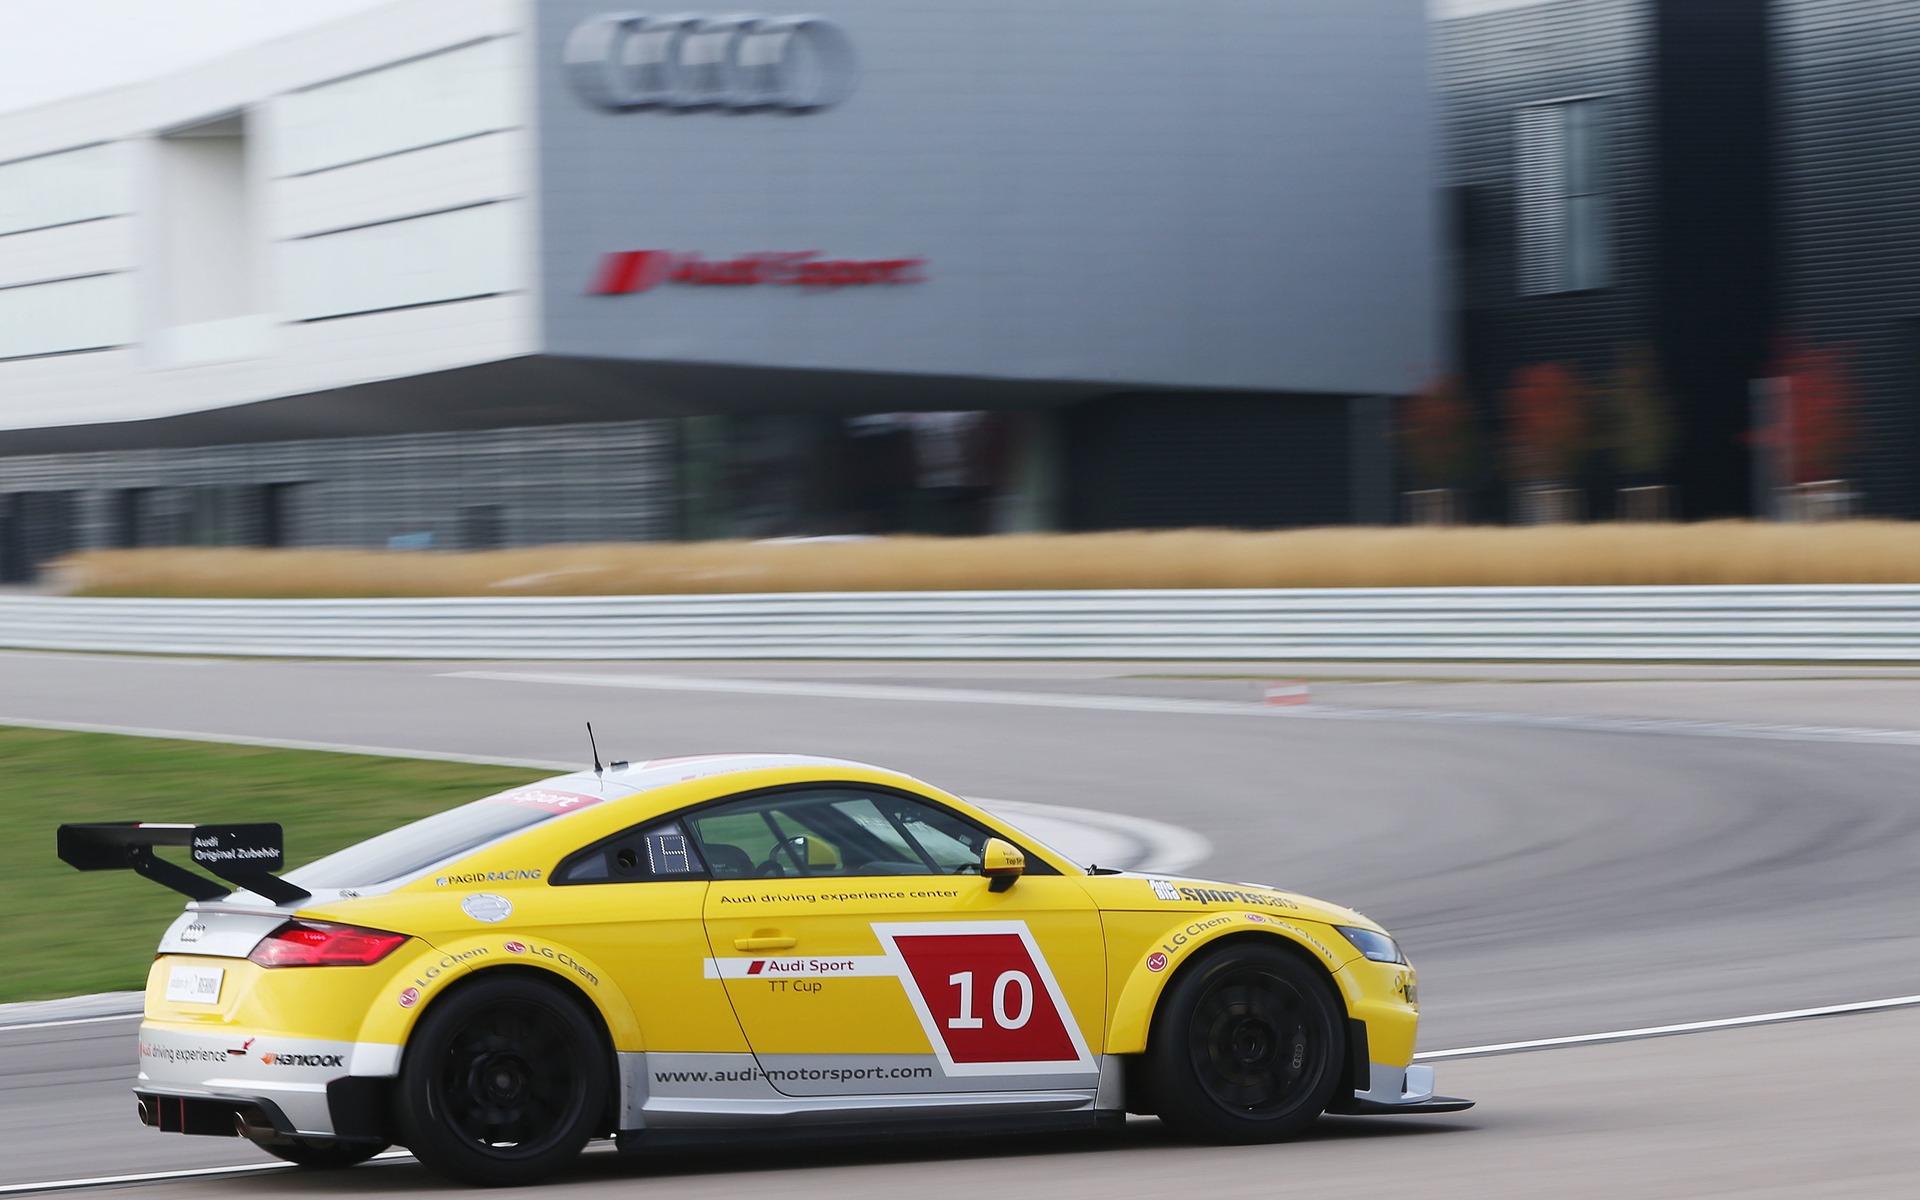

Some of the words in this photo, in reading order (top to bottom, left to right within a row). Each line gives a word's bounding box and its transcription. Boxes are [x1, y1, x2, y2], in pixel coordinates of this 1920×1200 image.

[194, 836, 219, 847] Audi
[194, 849, 236, 862] Original
[237, 848, 280, 859] Zubehör
[448, 873, 485, 885] PAGID
[486, 869, 542, 881] RACING
[720, 895, 756, 904] Audi
[761, 893, 816, 902] driving
[821, 891, 905, 901] experience
[910, 890, 959, 898] center
[1163, 933, 1188, 953] LG
[1186, 916, 1232, 936] Chem
[416, 965, 441, 987] LG
[440, 947, 489, 968] Chem
[529, 945, 555, 959] LG
[557, 953, 599, 986] Chem
[768, 960, 805, 972] Audi
[809, 960, 854, 974] Sport
[768, 980, 789, 992] TT
[793, 980, 822, 994] Cup
[948, 970, 1034, 1030] 10
[152, 1045, 174, 1063] driving
[175, 1048, 227, 1063] experience
[655, 1066, 932, 1086] www.audi-motorsport.com
